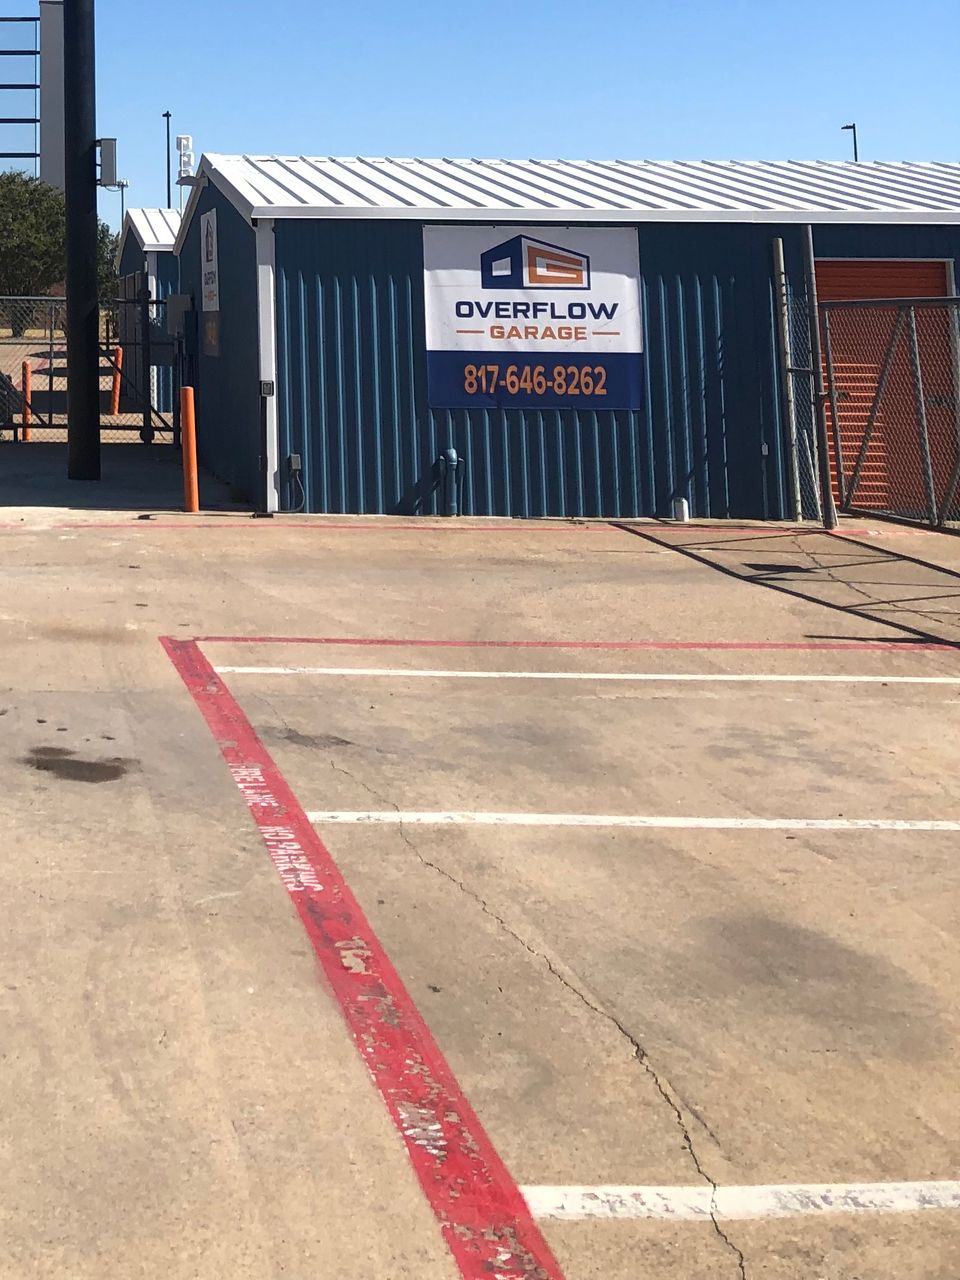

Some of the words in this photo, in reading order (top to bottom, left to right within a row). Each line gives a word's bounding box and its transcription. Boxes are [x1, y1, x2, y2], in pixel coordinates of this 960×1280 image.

[455, 301, 619, 320] OVERFLOW
[490, 325, 588, 340] GARAGE
[463, 363, 608, 396] 817-646-8262
[258, 825, 296, 840] NO
[266, 841, 324, 891] PARKING
